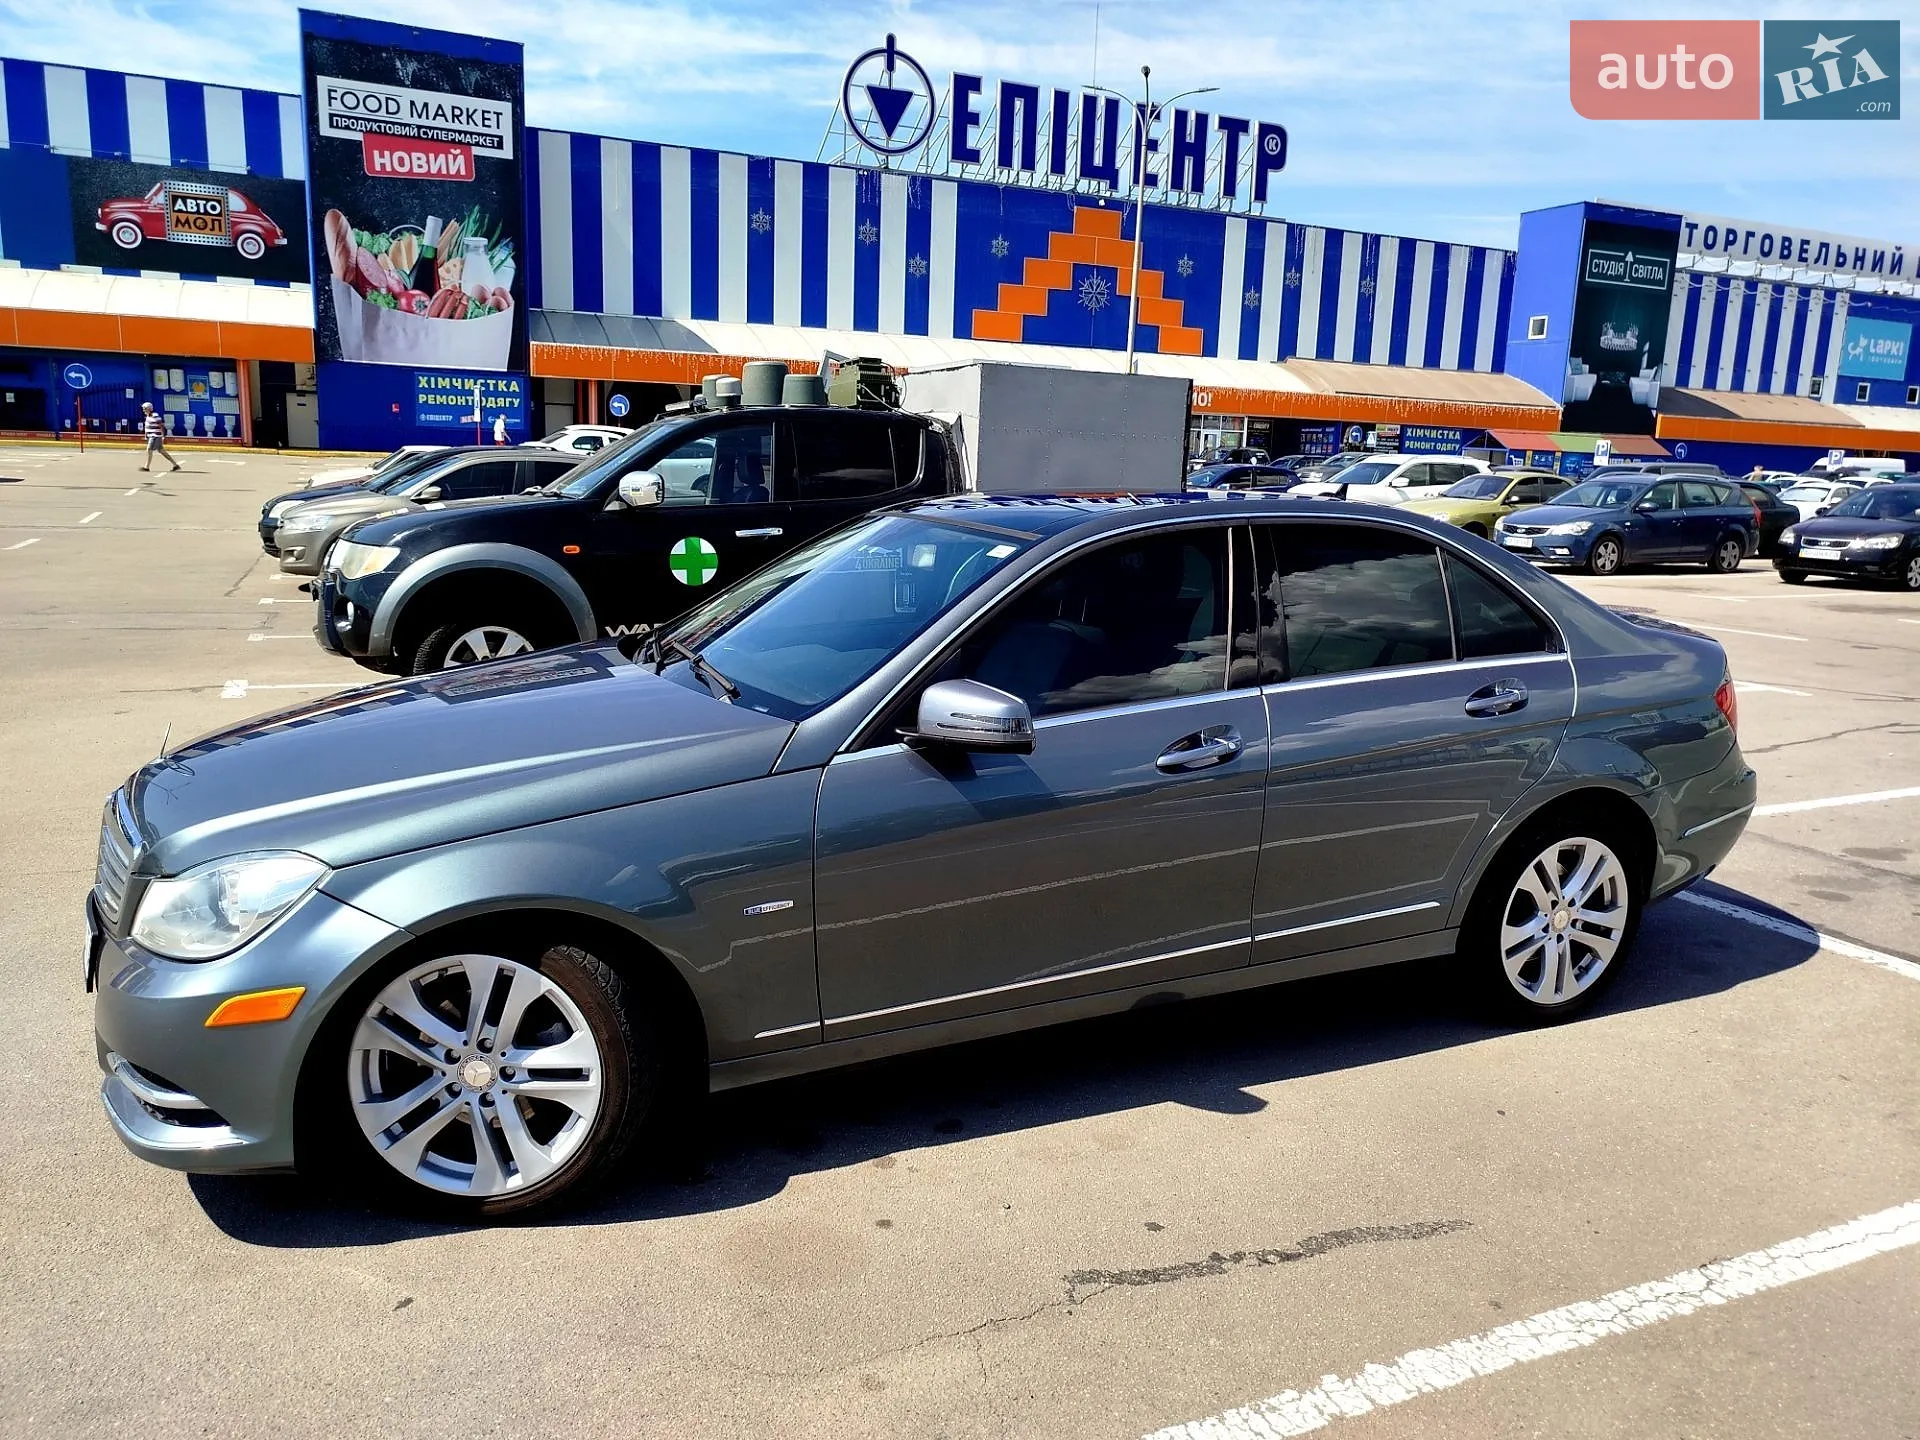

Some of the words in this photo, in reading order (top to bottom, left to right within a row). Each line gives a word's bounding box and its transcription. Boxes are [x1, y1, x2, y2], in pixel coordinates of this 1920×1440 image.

[327, 88, 400, 115] FOOD
[409, 100, 503, 129] MARKET
[333, 116, 419, 136] ПРОДУКТОВИЙ
[419, 128, 500, 147] СУПЕРМАРКЕТ
[950, 72, 1288, 204] ЕПІЦЕНТР
[373, 148, 467, 176] НОВИЙ
[173, 198, 221, 215] АВТО
[174, 215, 222, 232] МОЛ
[1685, 222, 1904, 278] ТОРГОВЕЛЬНИЙ
[1592, 259, 1625, 276] СТУДІЯ
[1631, 263, 1663, 281] СВІТЛА
[418, 376, 520, 392] ХІМЧИСТКА
[418, 394, 474, 406] РЕМОНТ
[1406, 427, 1461, 440] ХІМЧИСТКА
[1405, 440, 1435, 451] РЕМОНТ
[1436, 443, 1460, 452] ОДЯГУ
